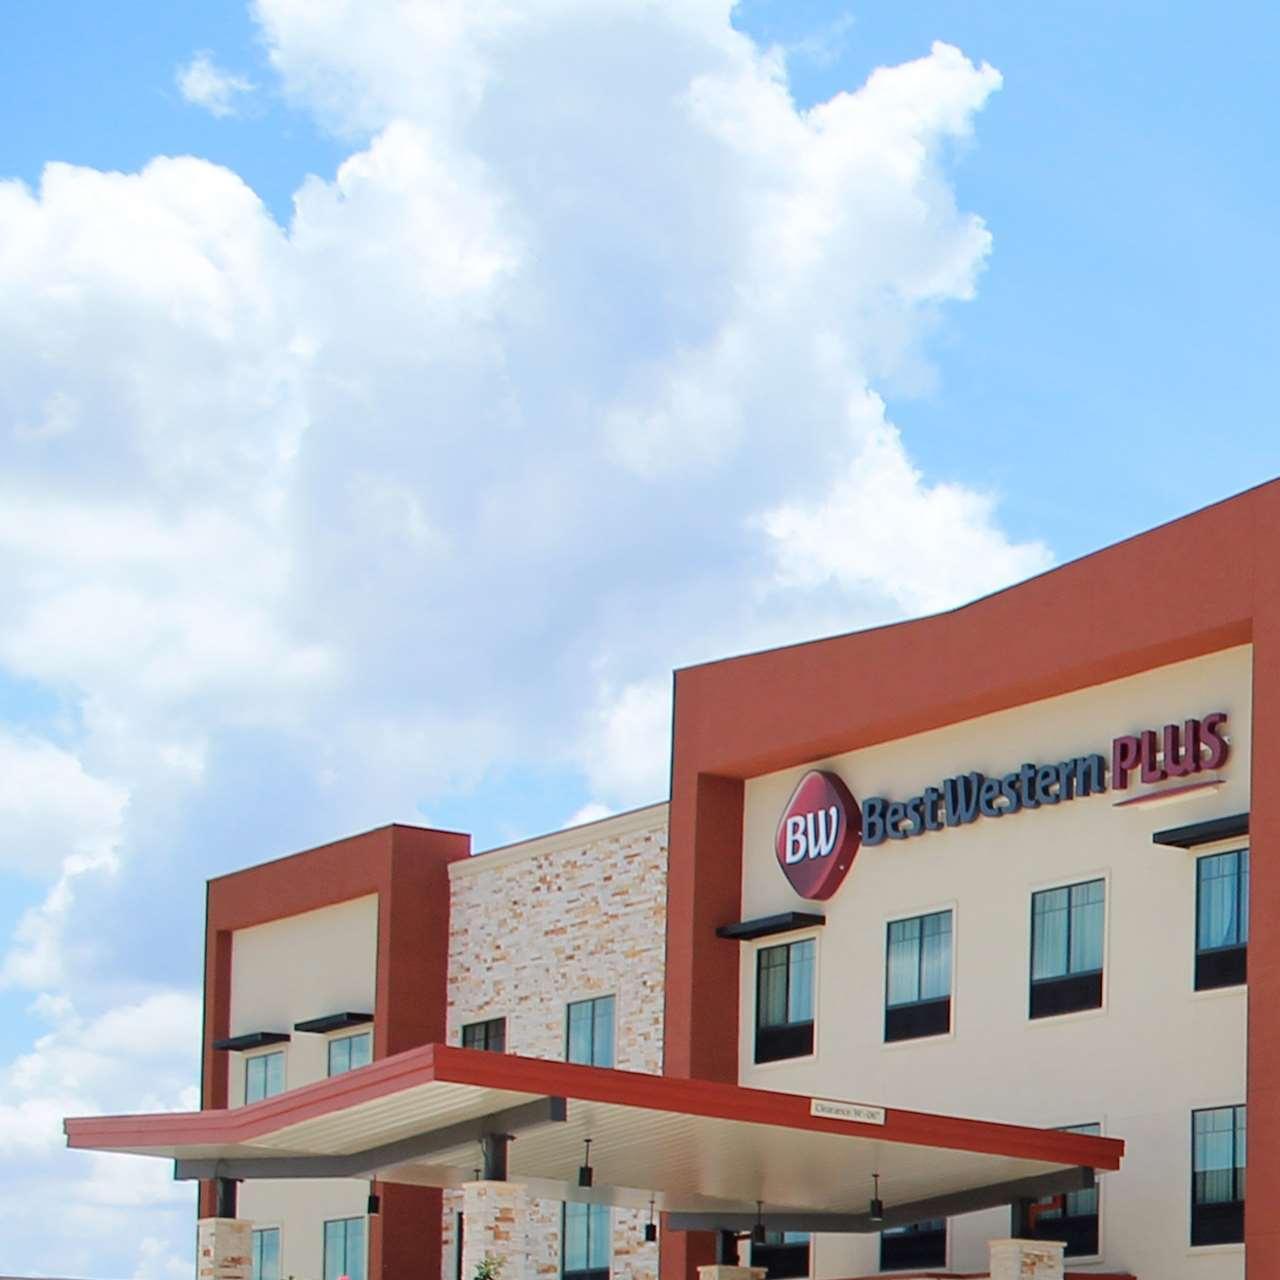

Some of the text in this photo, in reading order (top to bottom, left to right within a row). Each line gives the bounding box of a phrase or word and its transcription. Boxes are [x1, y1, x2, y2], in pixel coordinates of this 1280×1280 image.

[862, 712, 1228, 846] Best Western PLUS
[785, 805, 839, 864] BW
